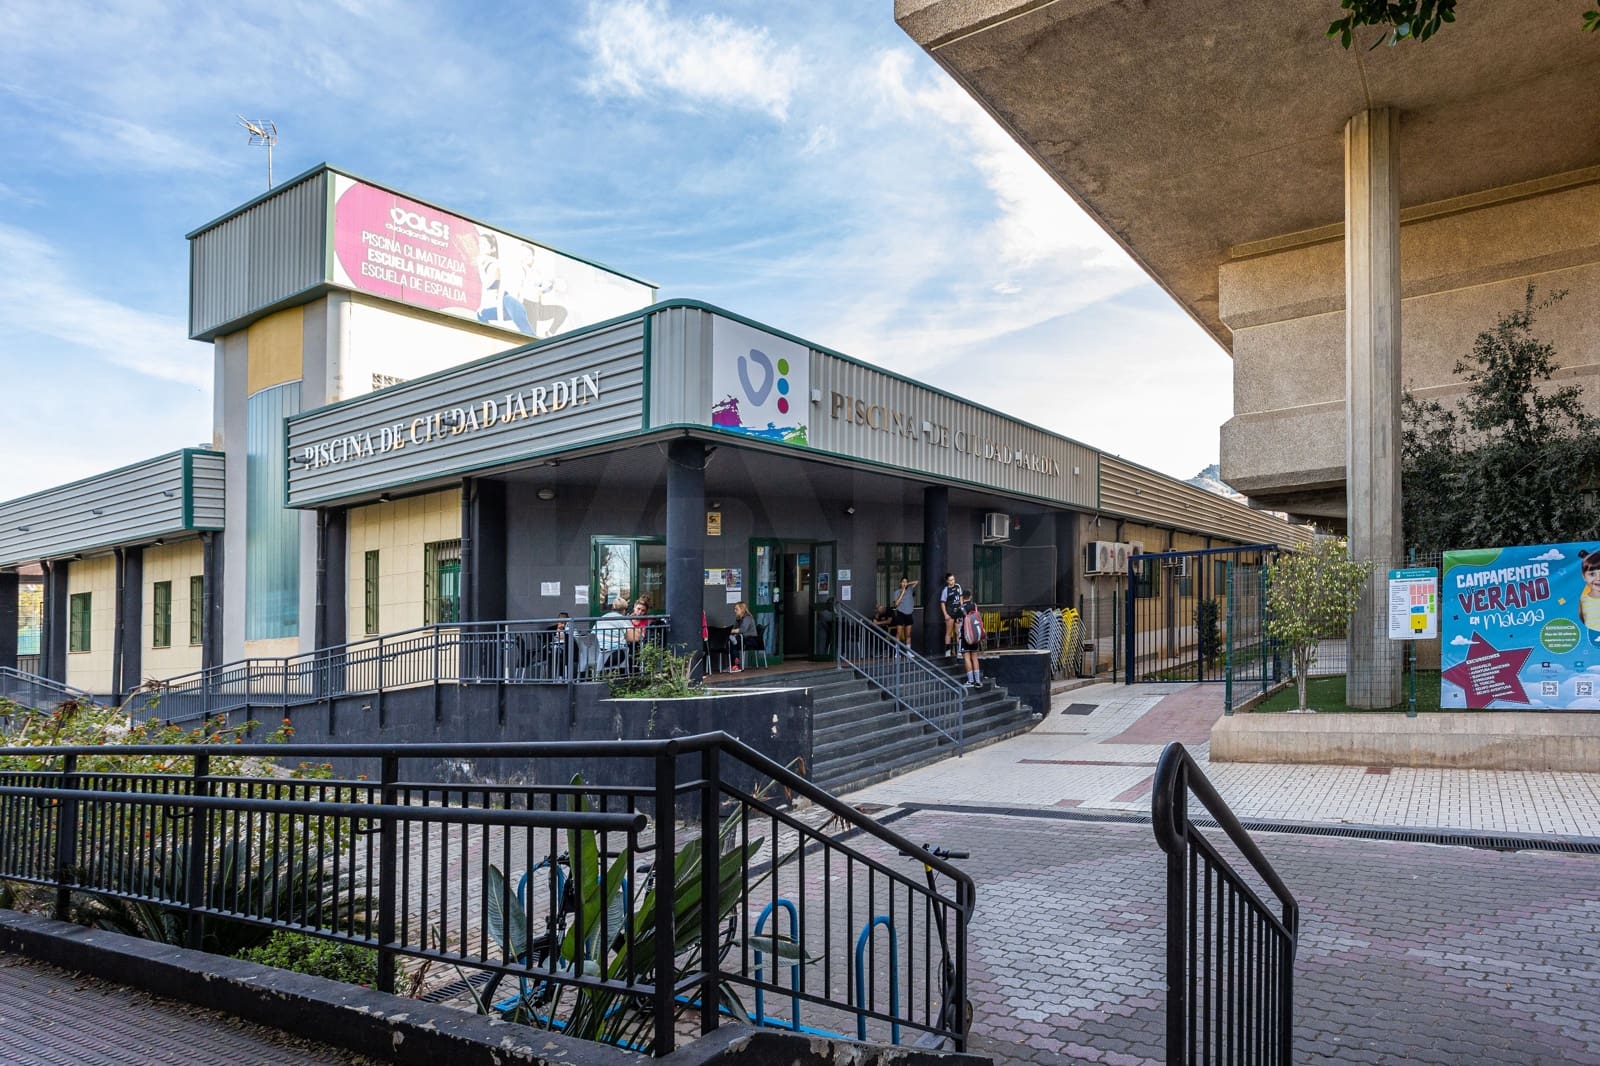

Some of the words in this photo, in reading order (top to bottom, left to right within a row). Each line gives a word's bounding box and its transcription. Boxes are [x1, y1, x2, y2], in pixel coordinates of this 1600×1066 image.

[362, 231, 401, 255] PISCINA
[403, 243, 466, 275] CLIMATIZADA
[368, 248, 415, 275] ESCUELA
[362, 262, 407, 287] ESCUELA
[410, 275, 423, 291] DE
[425, 280, 467, 303] ESPALDA
[304, 432, 375, 470] PISCINA
[380, 423, 405, 453] DE
[501, 370, 601, 424] JARDIN
[831, 391, 918, 440] PISCINA
[928, 422, 949, 448] DE
[954, 430, 1012, 465] CIUDAD
[1016, 448, 1060, 477] JARDIN
[1456, 562, 1550, 588] CAMPAMENTOS
[1458, 577, 1551, 614] VERANO
[1469, 616, 1480, 625] EN
